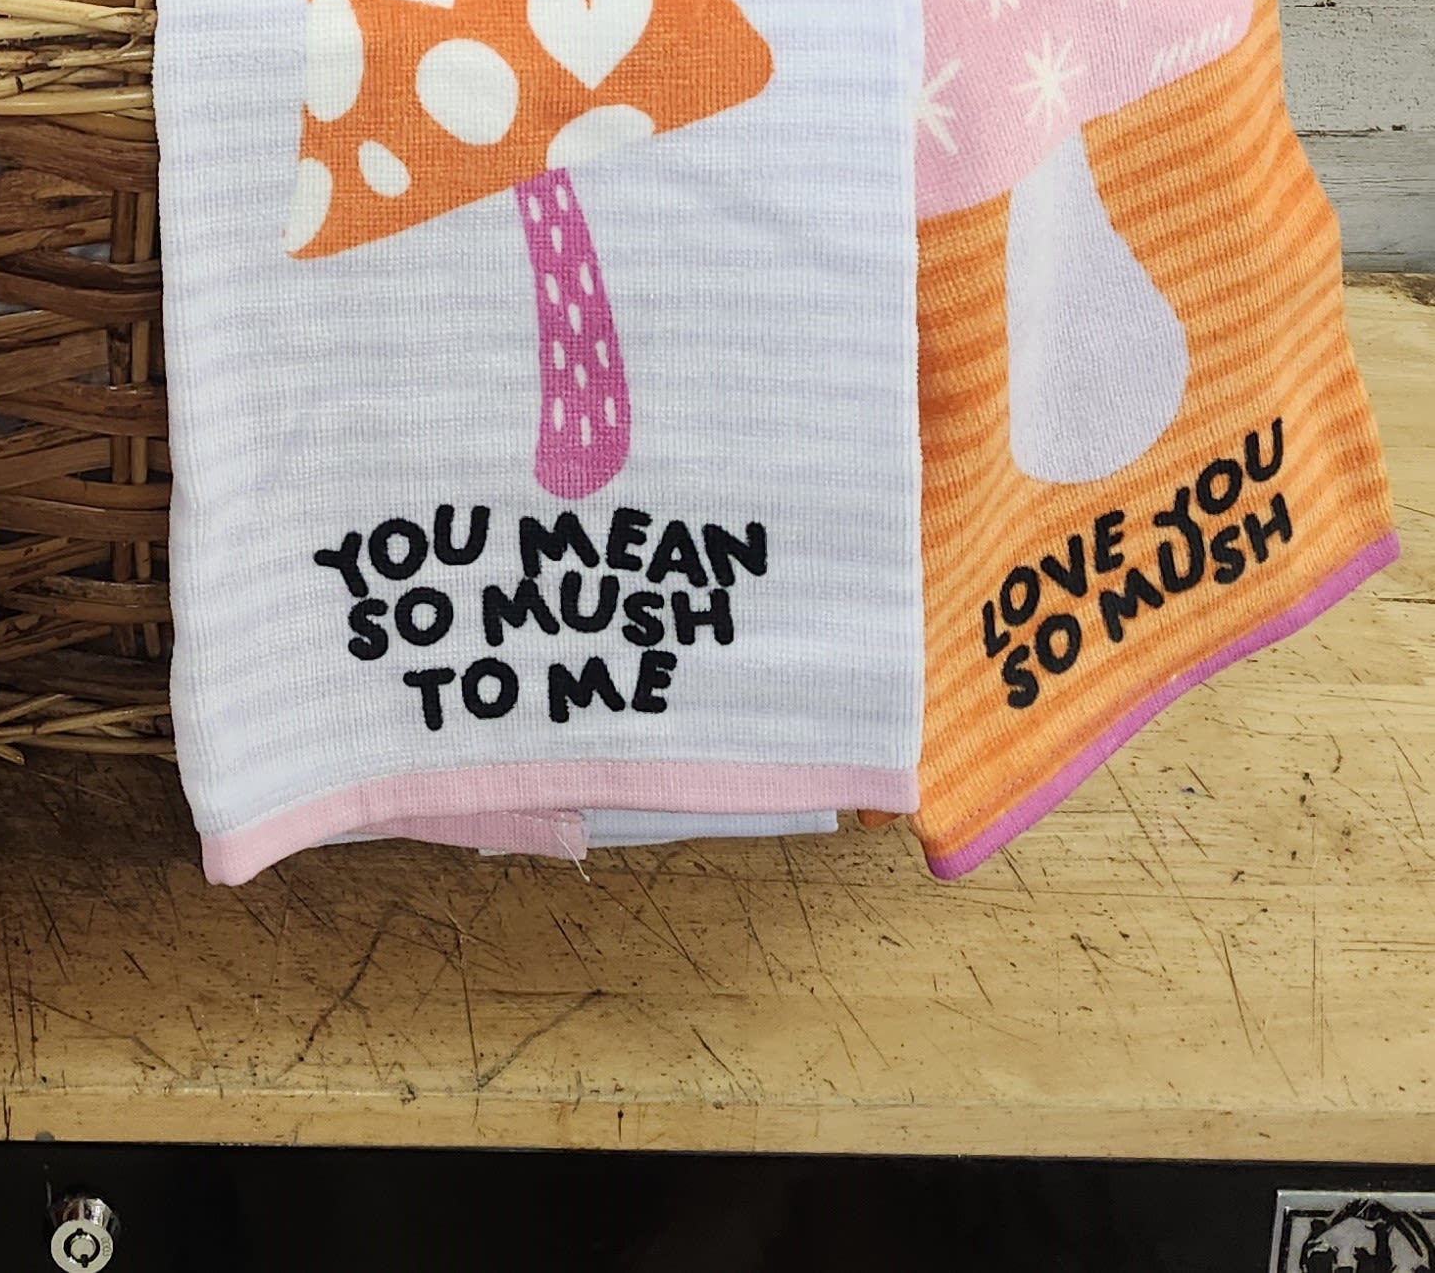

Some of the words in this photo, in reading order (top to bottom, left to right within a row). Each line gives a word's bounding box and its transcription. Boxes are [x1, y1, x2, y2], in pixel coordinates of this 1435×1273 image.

[313, 504, 490, 598] YOU
[518, 506, 768, 588] MEAN
[982, 509, 1125, 658] LOVE
[1153, 416, 1284, 529] YOU
[347, 586, 454, 661] SO
[482, 570, 735, 647] MUSH
[1001, 613, 1083, 710] SO
[1099, 493, 1293, 643] MUSH
[402, 657, 519, 731] TO
[547, 649, 678, 724] ME
